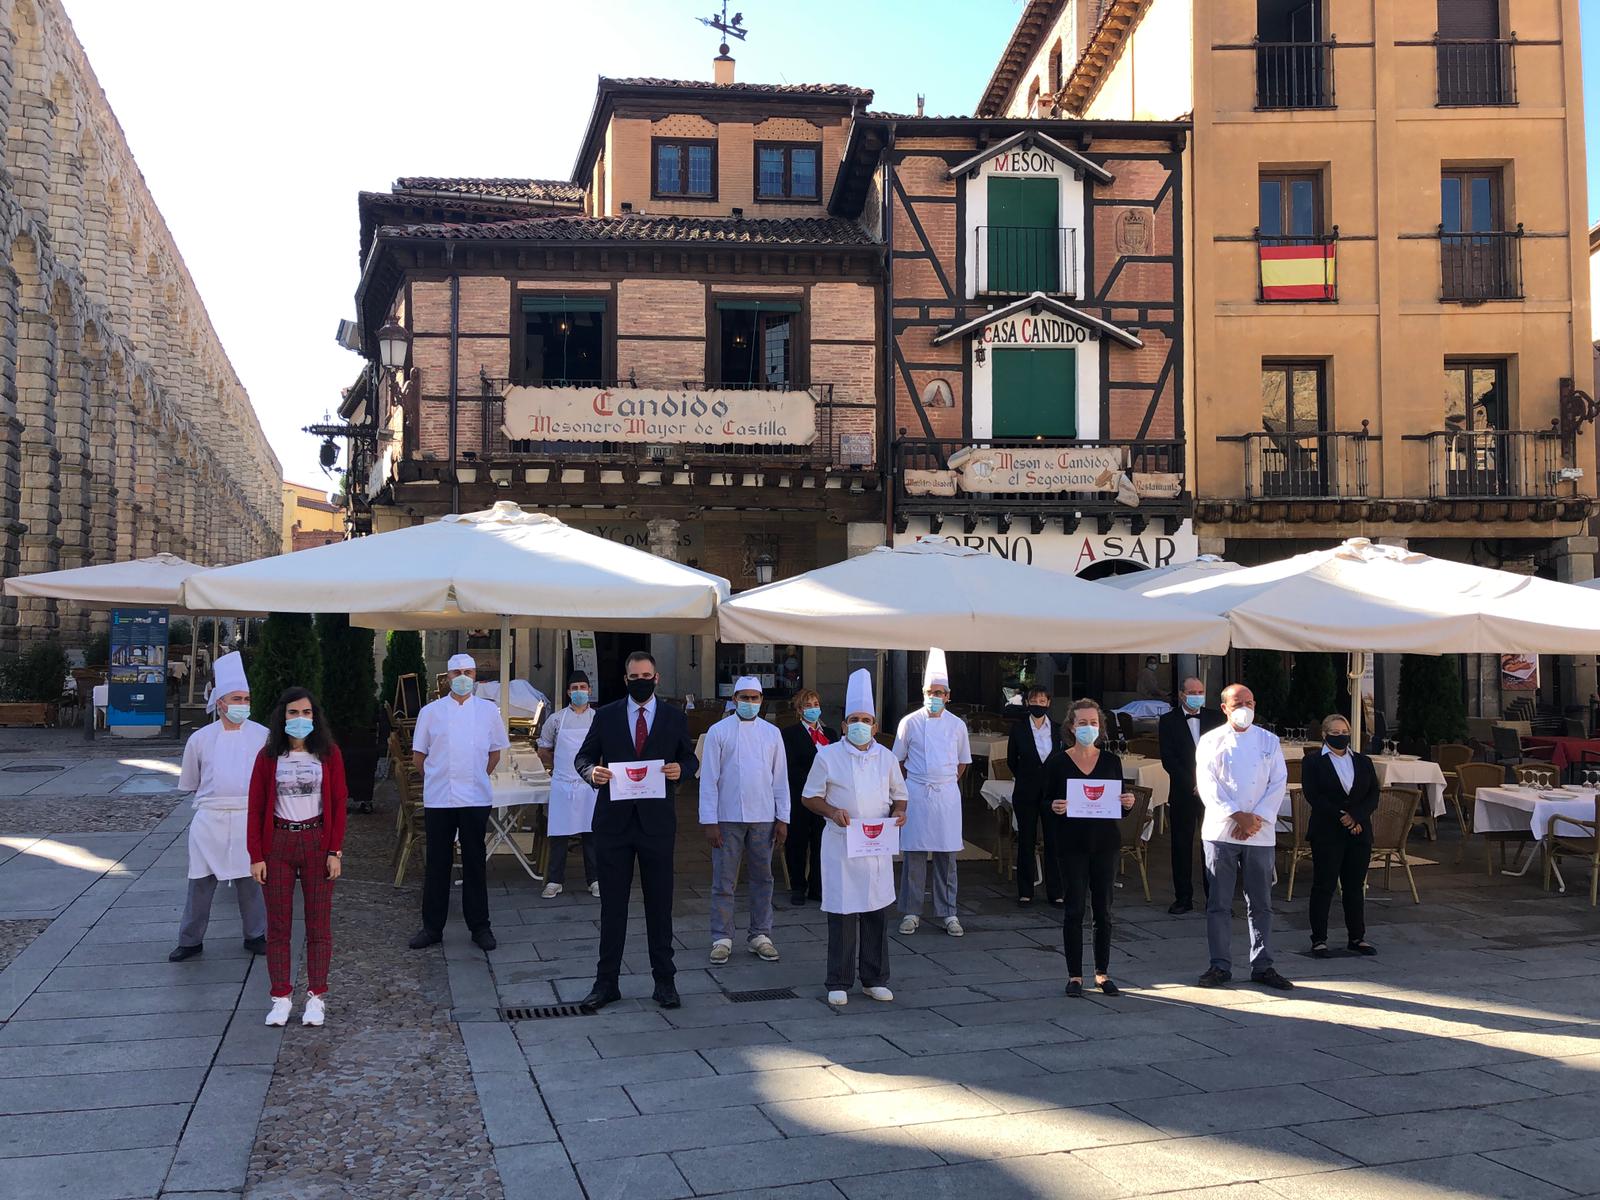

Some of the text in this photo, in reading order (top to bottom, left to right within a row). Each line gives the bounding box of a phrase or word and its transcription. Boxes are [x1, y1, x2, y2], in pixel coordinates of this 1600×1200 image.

[994, 151, 1055, 172] MESON
[983, 318, 1086, 343] CASA CANDIDO
[592, 391, 729, 417] Candido
[528, 415, 787, 439] Mesonero Mayor de Castilla
[1044, 461, 1054, 469] de
[1057, 453, 1109, 469] Candido
[1008, 471, 1094, 489] el Segoviano
[1073, 536, 1176, 572] ASAR
